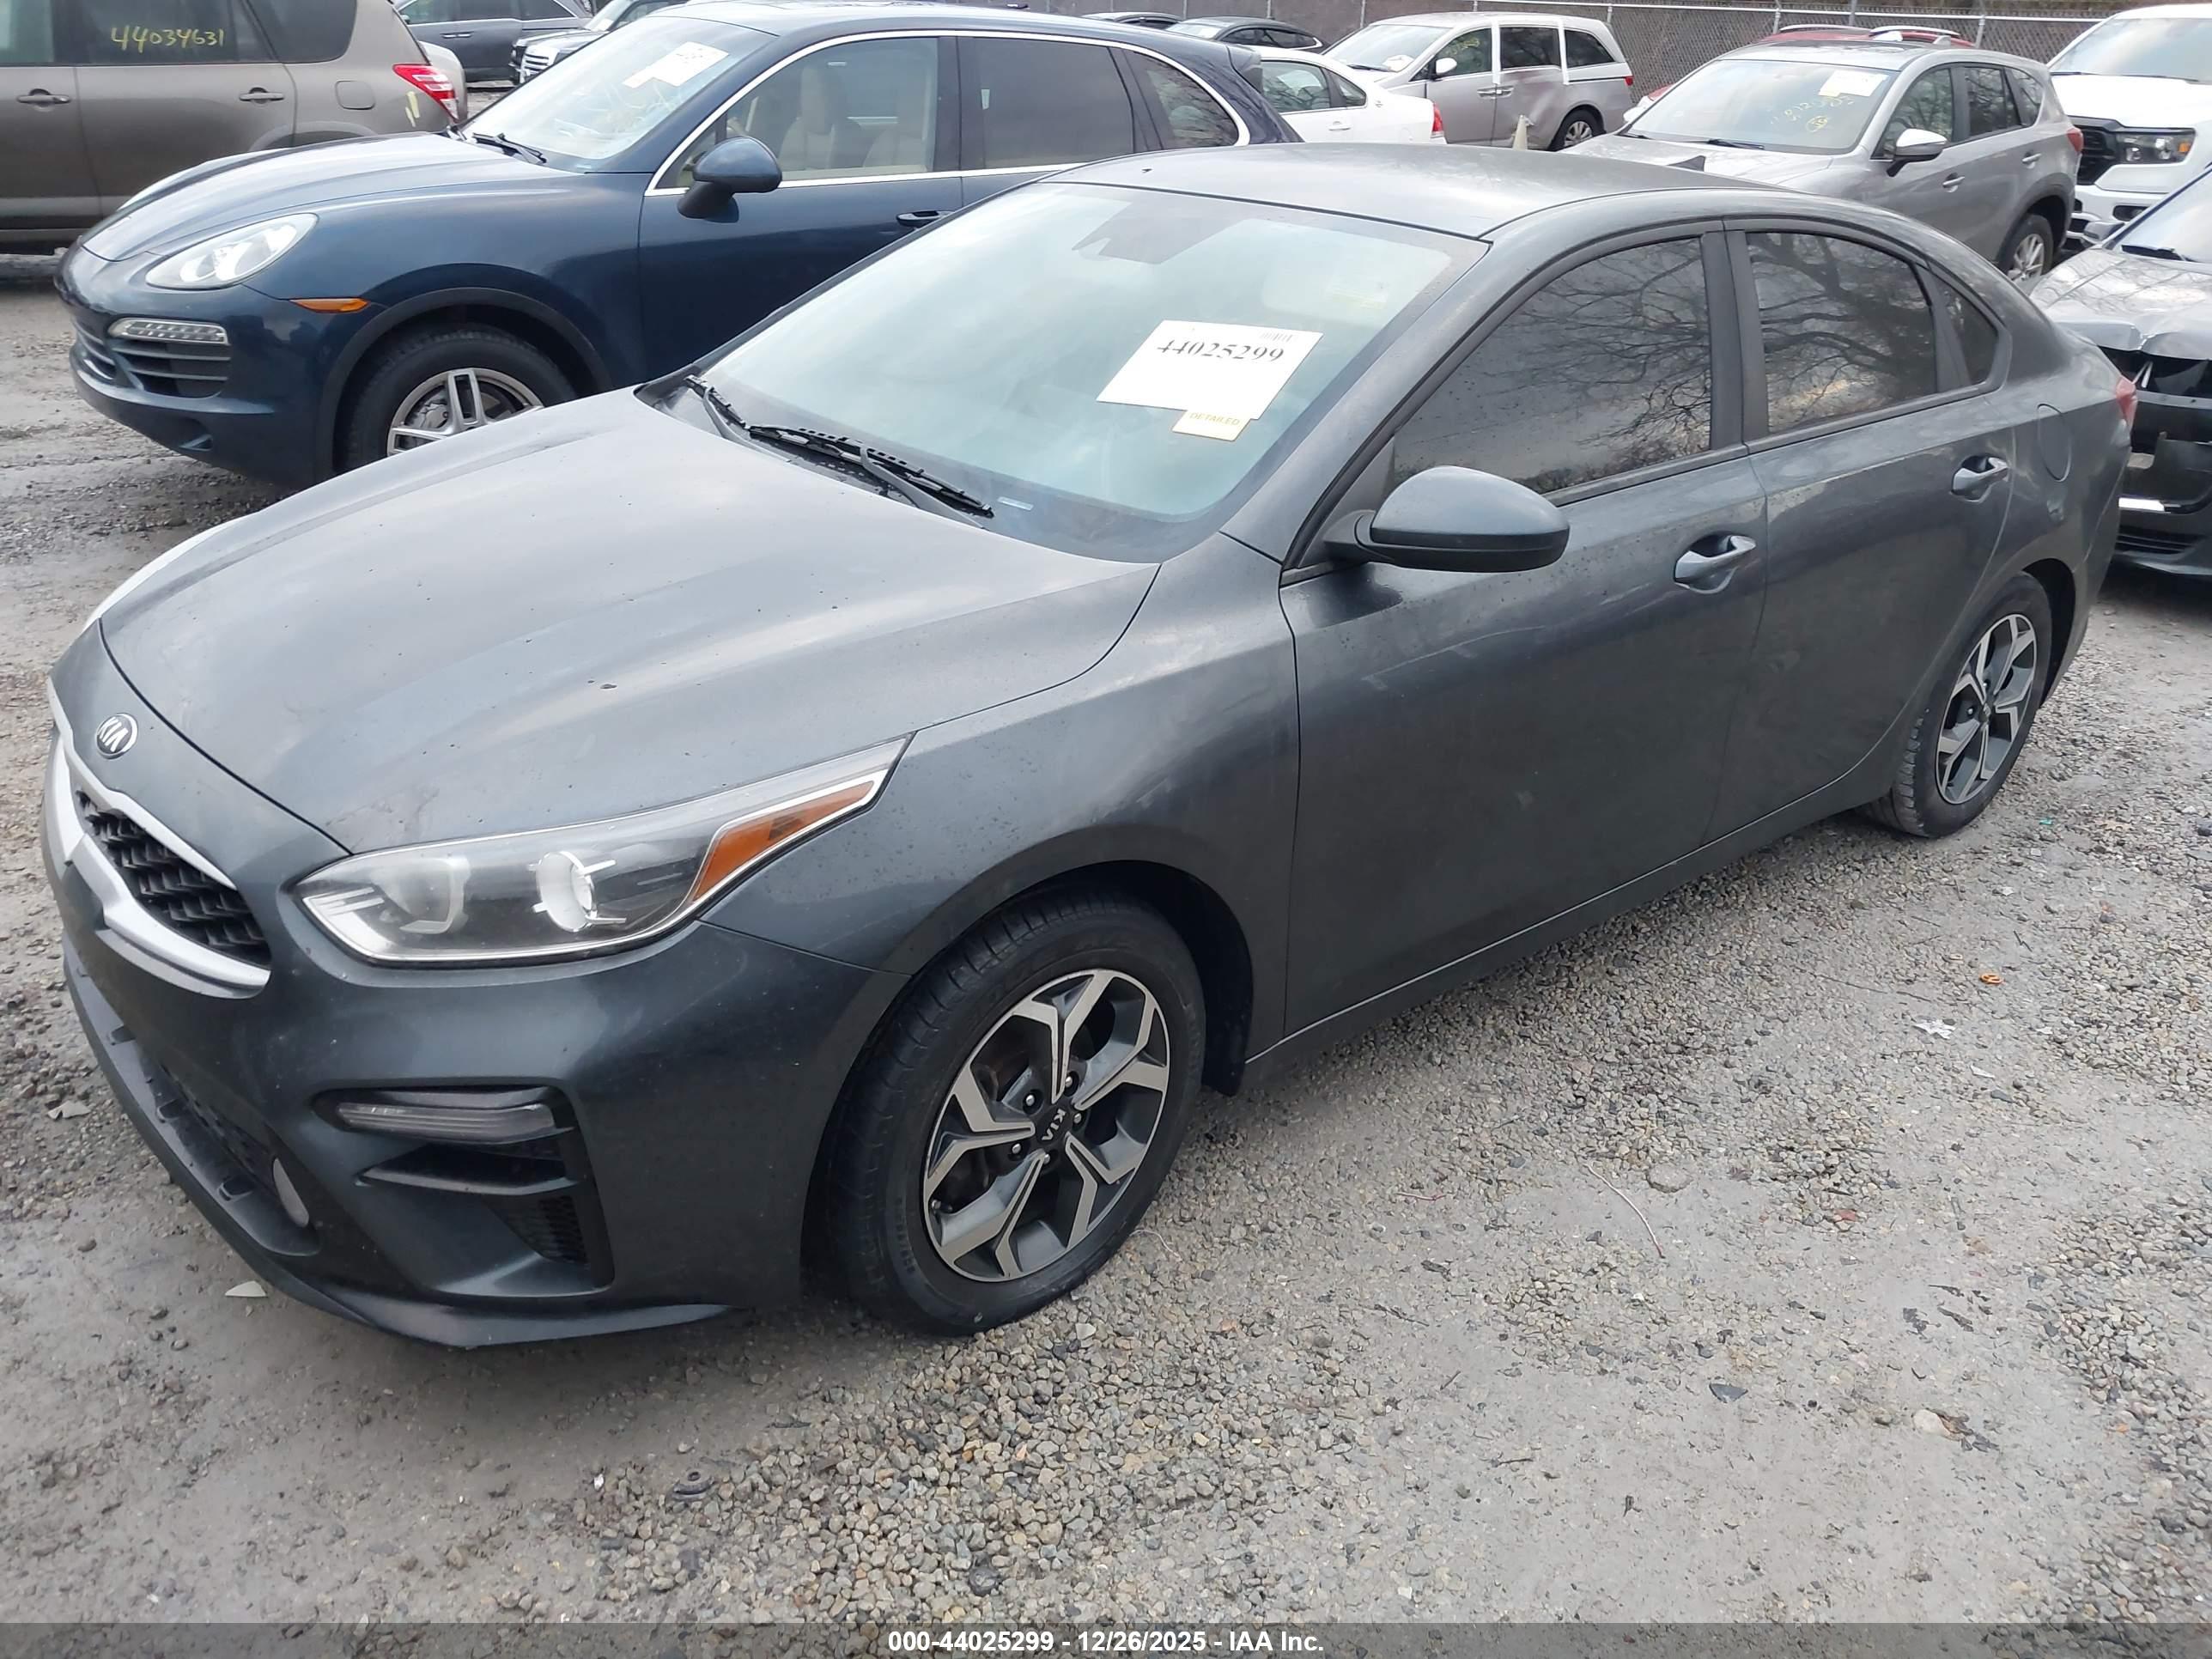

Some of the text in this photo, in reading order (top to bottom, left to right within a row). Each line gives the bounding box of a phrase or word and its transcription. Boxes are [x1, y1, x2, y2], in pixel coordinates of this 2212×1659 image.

[110, 26, 225, 53] 44034631
[1156, 338, 1285, 362] 44025299
[1188, 411, 1241, 426] DETAILED
[1042, 1108, 1066, 1141] KIA
